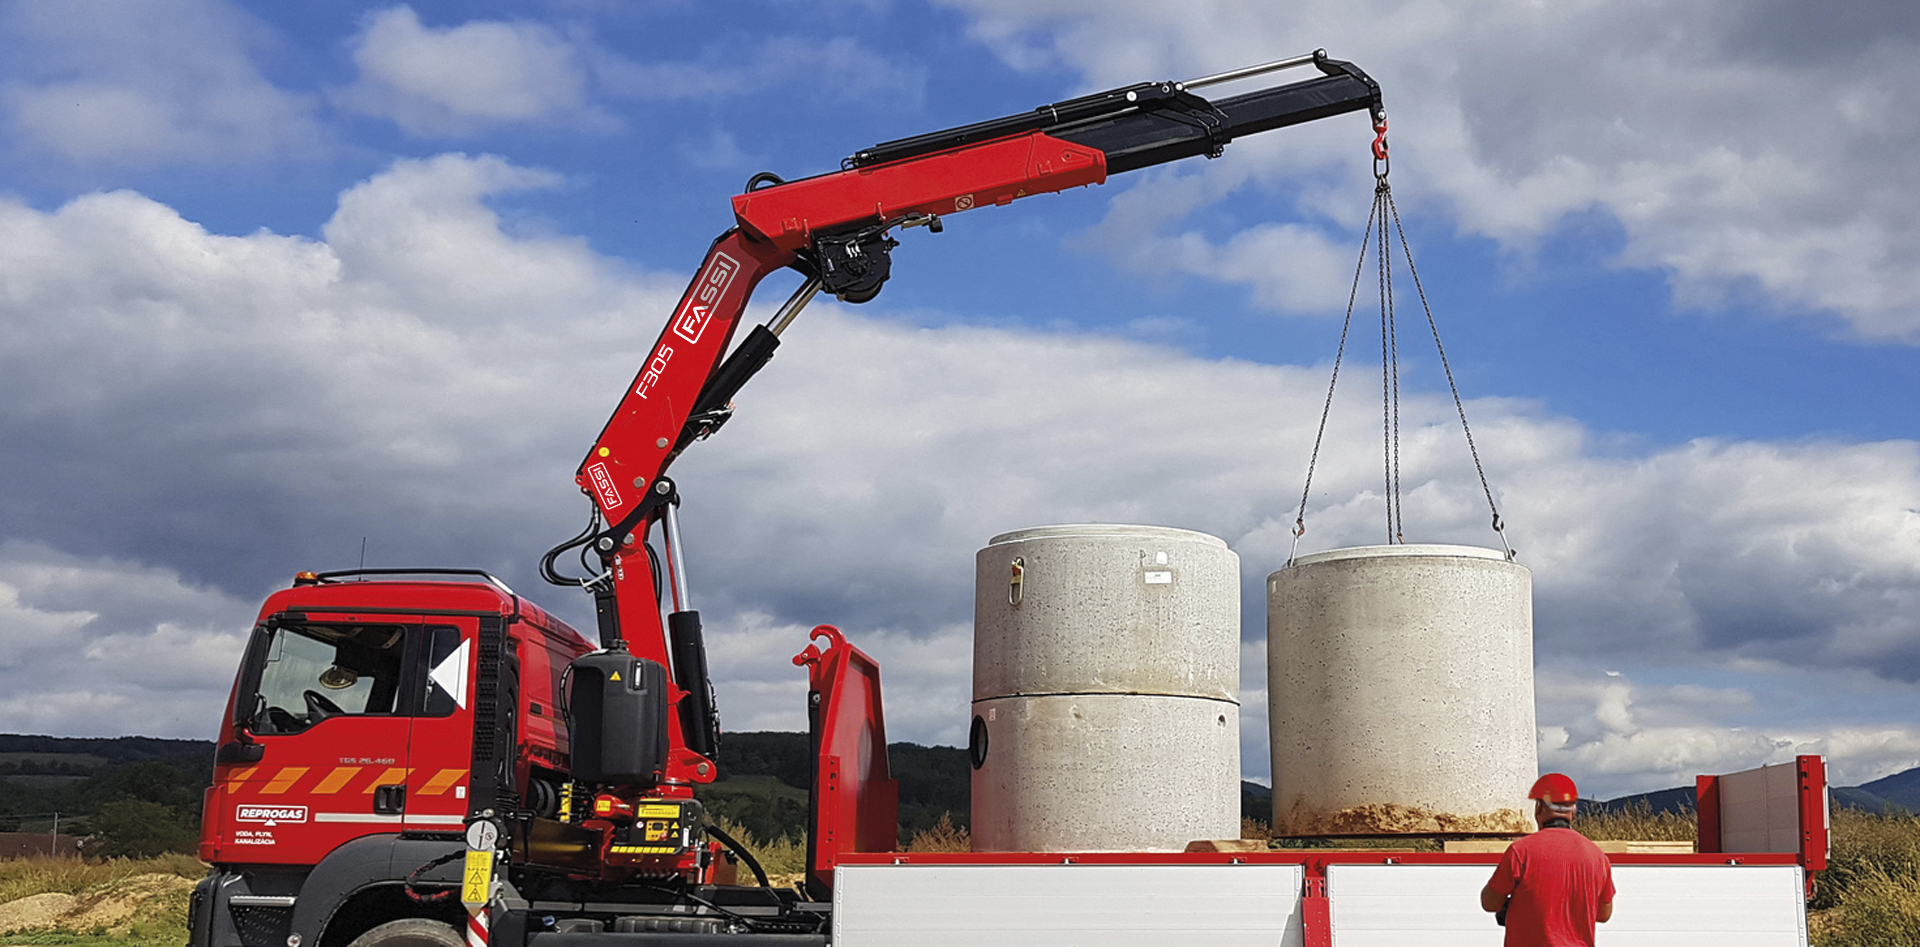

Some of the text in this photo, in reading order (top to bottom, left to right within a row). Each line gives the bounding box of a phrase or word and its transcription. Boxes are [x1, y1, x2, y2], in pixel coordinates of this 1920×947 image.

[682, 261, 731, 335] FASSI
[636, 344, 673, 399] F305
[593, 467, 617, 505] FASSI
[240, 809, 303, 819] REPROGAS
